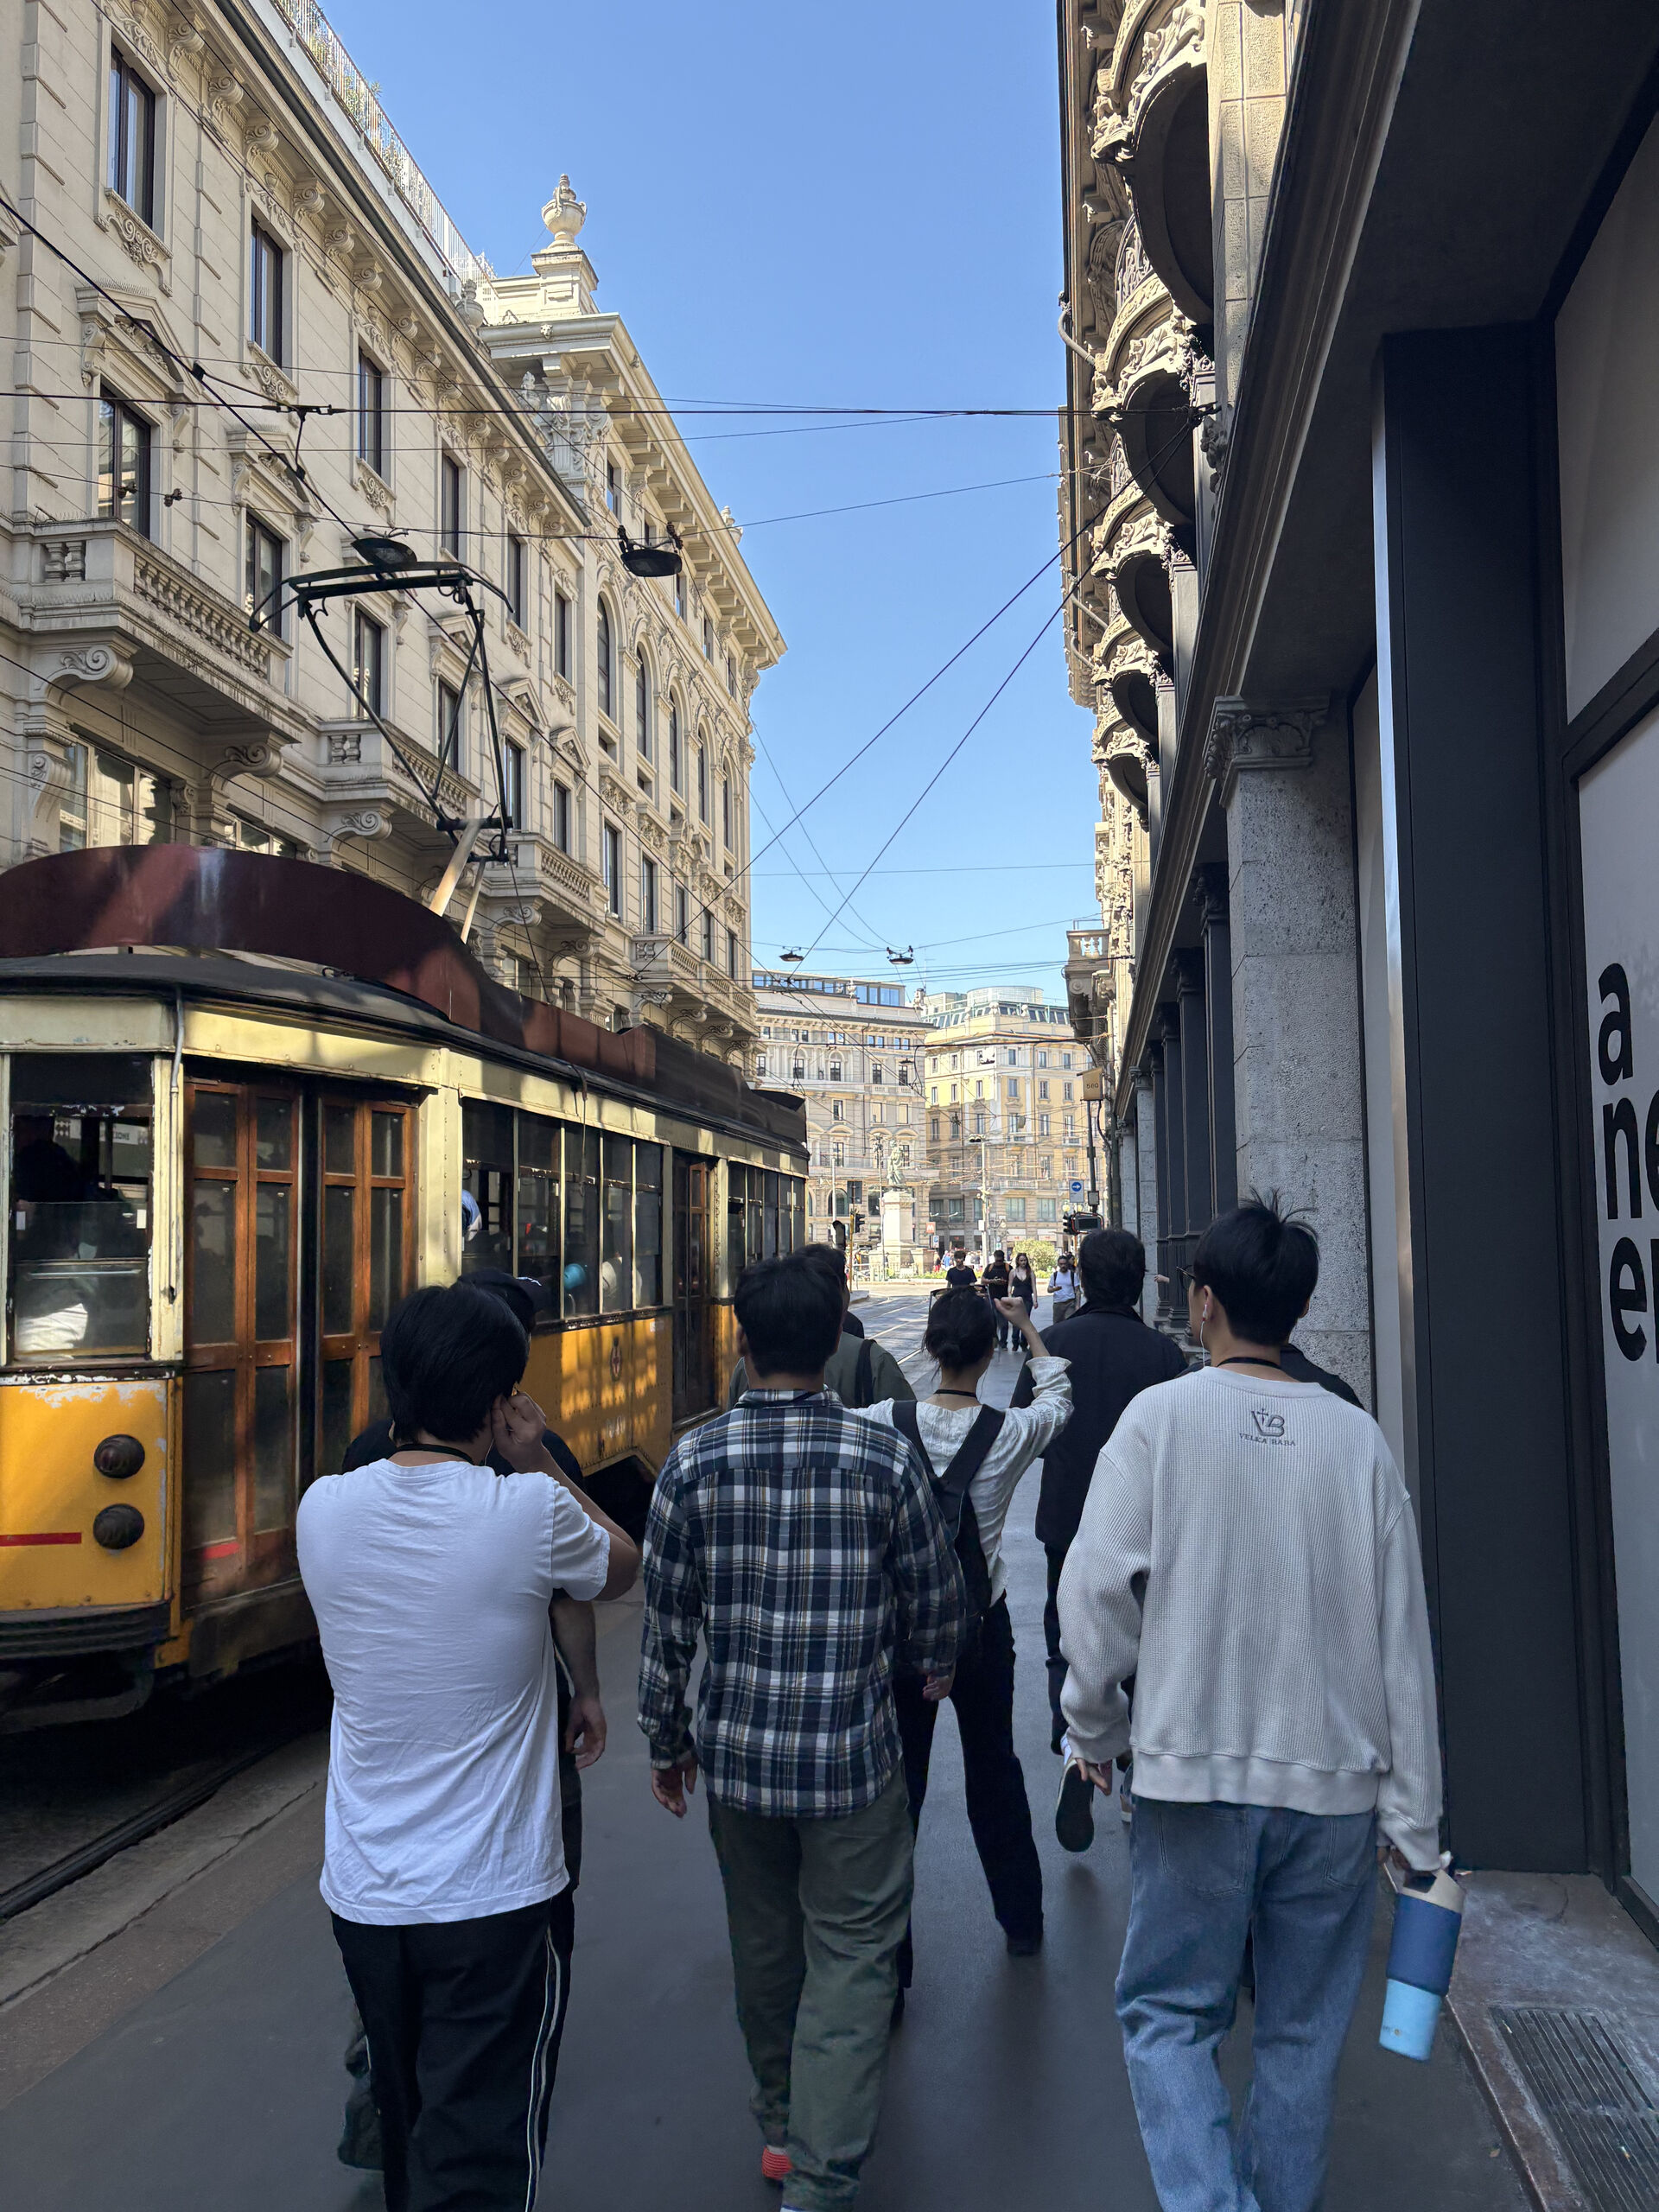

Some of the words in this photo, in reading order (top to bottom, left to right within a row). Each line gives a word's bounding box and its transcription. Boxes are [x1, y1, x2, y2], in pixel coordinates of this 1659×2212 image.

[1598, 963, 1634, 1086] a
[926, 1223, 934, 1231] M
[1610, 1236, 1659, 1364] e
